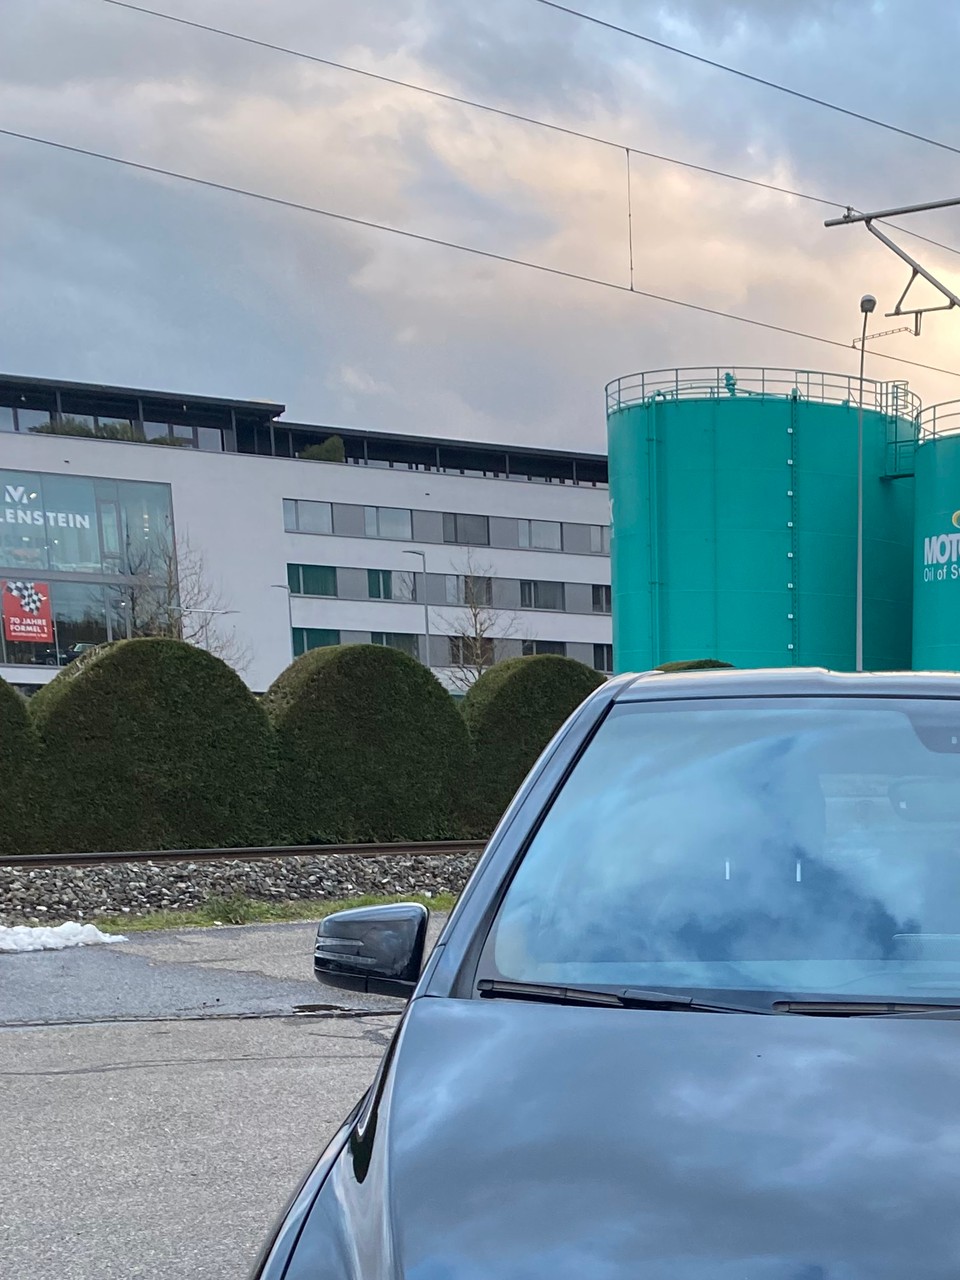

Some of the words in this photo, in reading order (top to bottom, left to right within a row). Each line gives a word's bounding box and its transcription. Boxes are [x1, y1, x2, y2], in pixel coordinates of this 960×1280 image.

[924, 568, 934, 582] Oil
[937, 566, 947, 580] of
[22, 618, 47, 626] JAHRE
[10, 624, 41, 633] FORMEL
